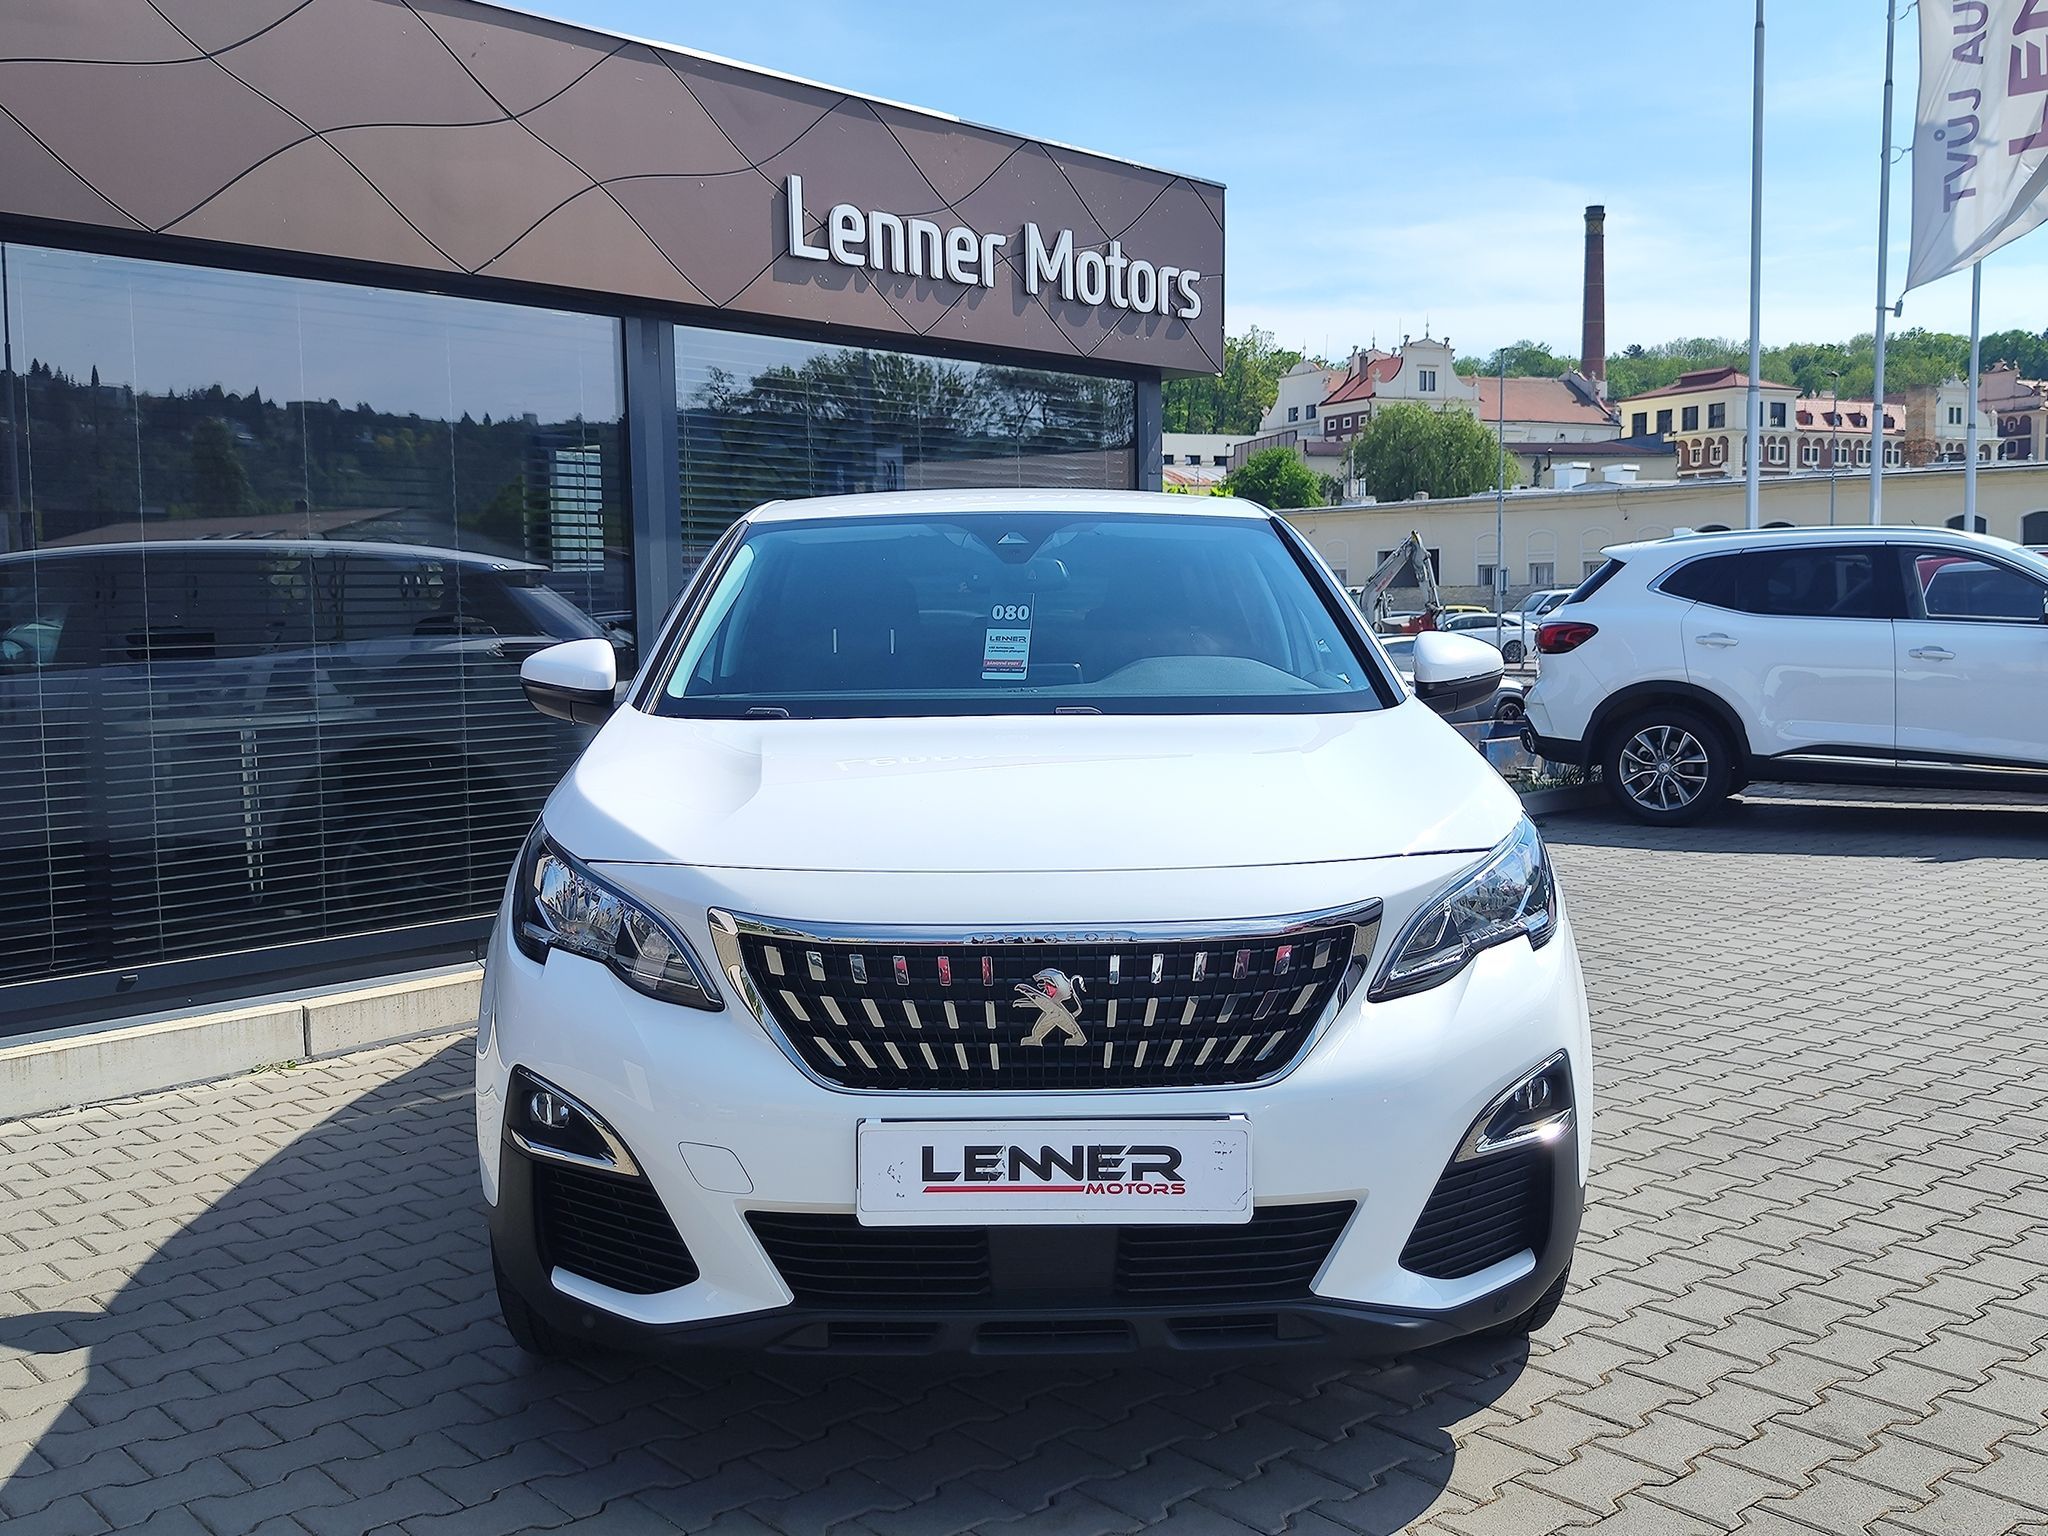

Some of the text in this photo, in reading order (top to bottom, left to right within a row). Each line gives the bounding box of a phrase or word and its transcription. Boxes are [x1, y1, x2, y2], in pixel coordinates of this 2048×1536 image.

[1934, 0, 1989, 213] TVŮJ AU
[786, 174, 1202, 320] Lenner Motors
[991, 604, 1030, 621] 080
[983, 932, 1119, 944] PEUGEOT
[921, 1145, 1186, 1182] LENNER
[1085, 1184, 1186, 1195] MOTORS
